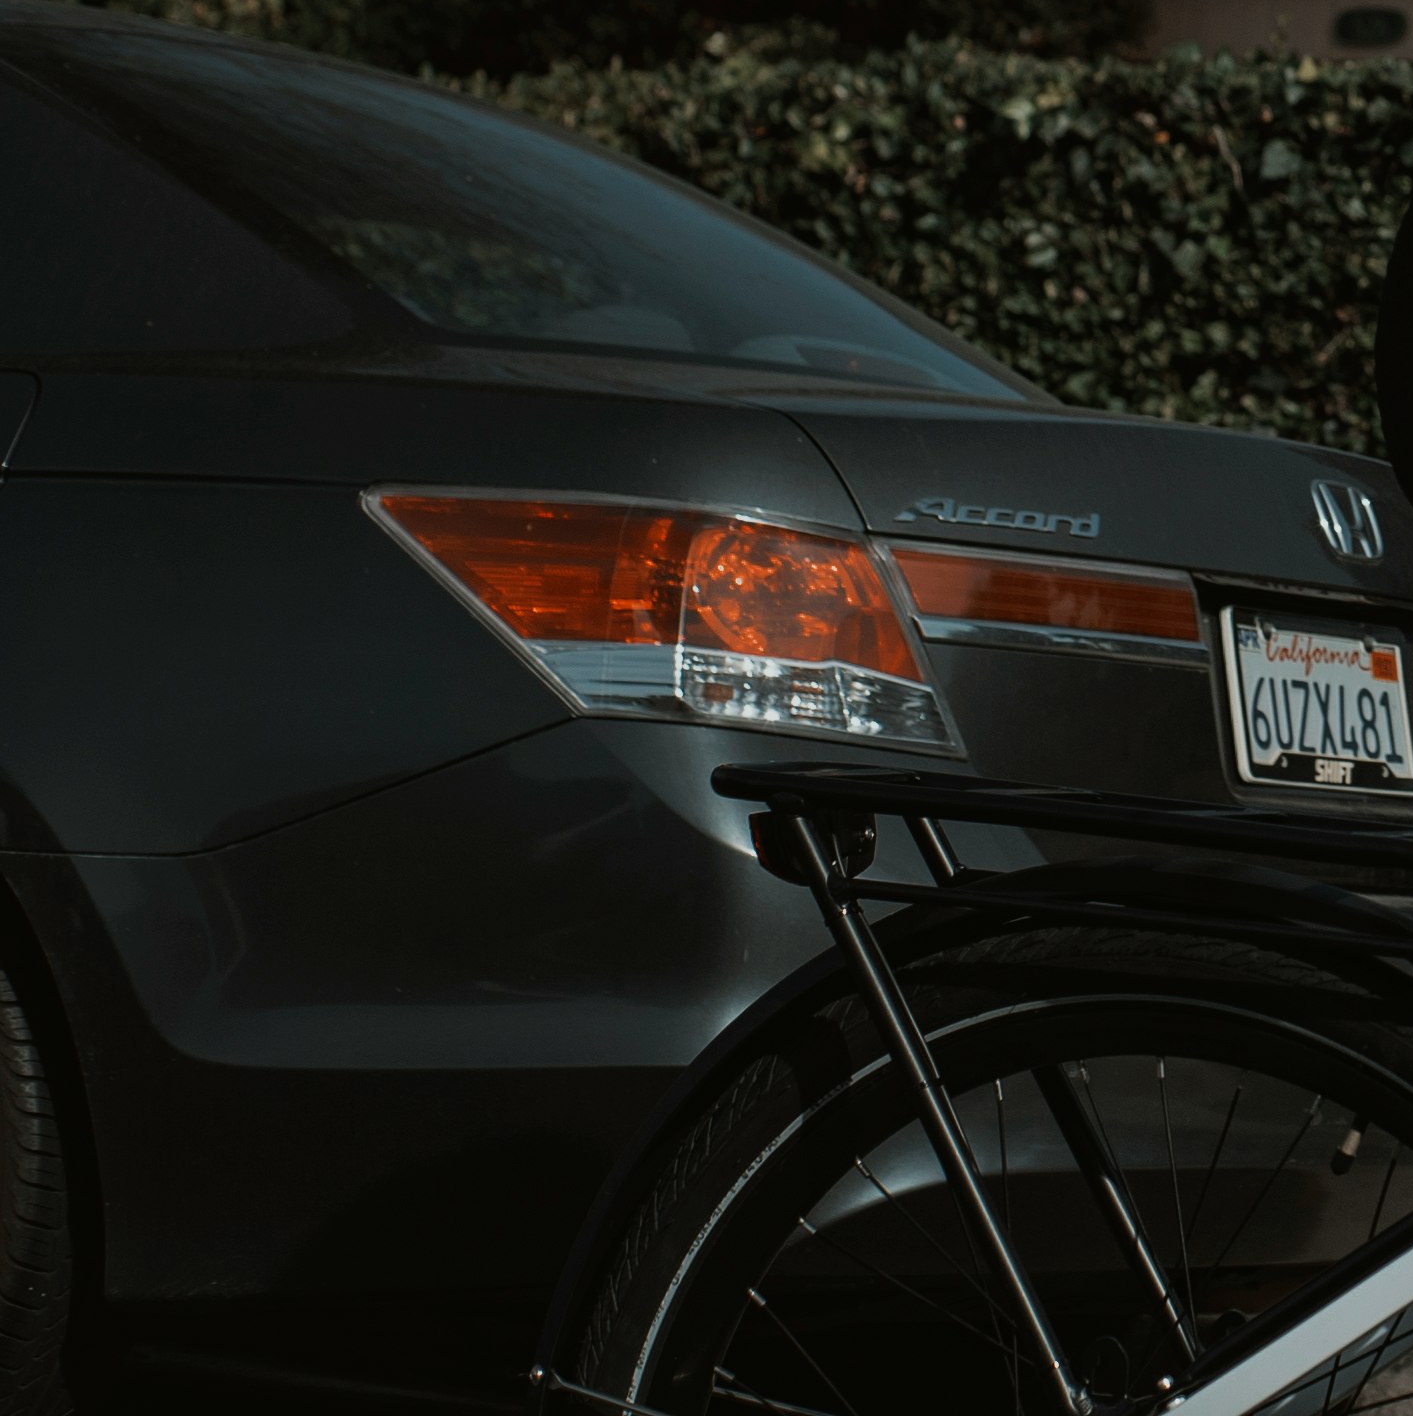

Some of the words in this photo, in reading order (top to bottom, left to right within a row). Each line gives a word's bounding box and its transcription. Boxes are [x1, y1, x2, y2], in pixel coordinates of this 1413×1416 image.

[893, 497, 1100, 539] Accord
[1265, 631, 1372, 677] California
[1252, 677, 1404, 764] 6UZX481
[1314, 758, 1355, 785] SHIFT
